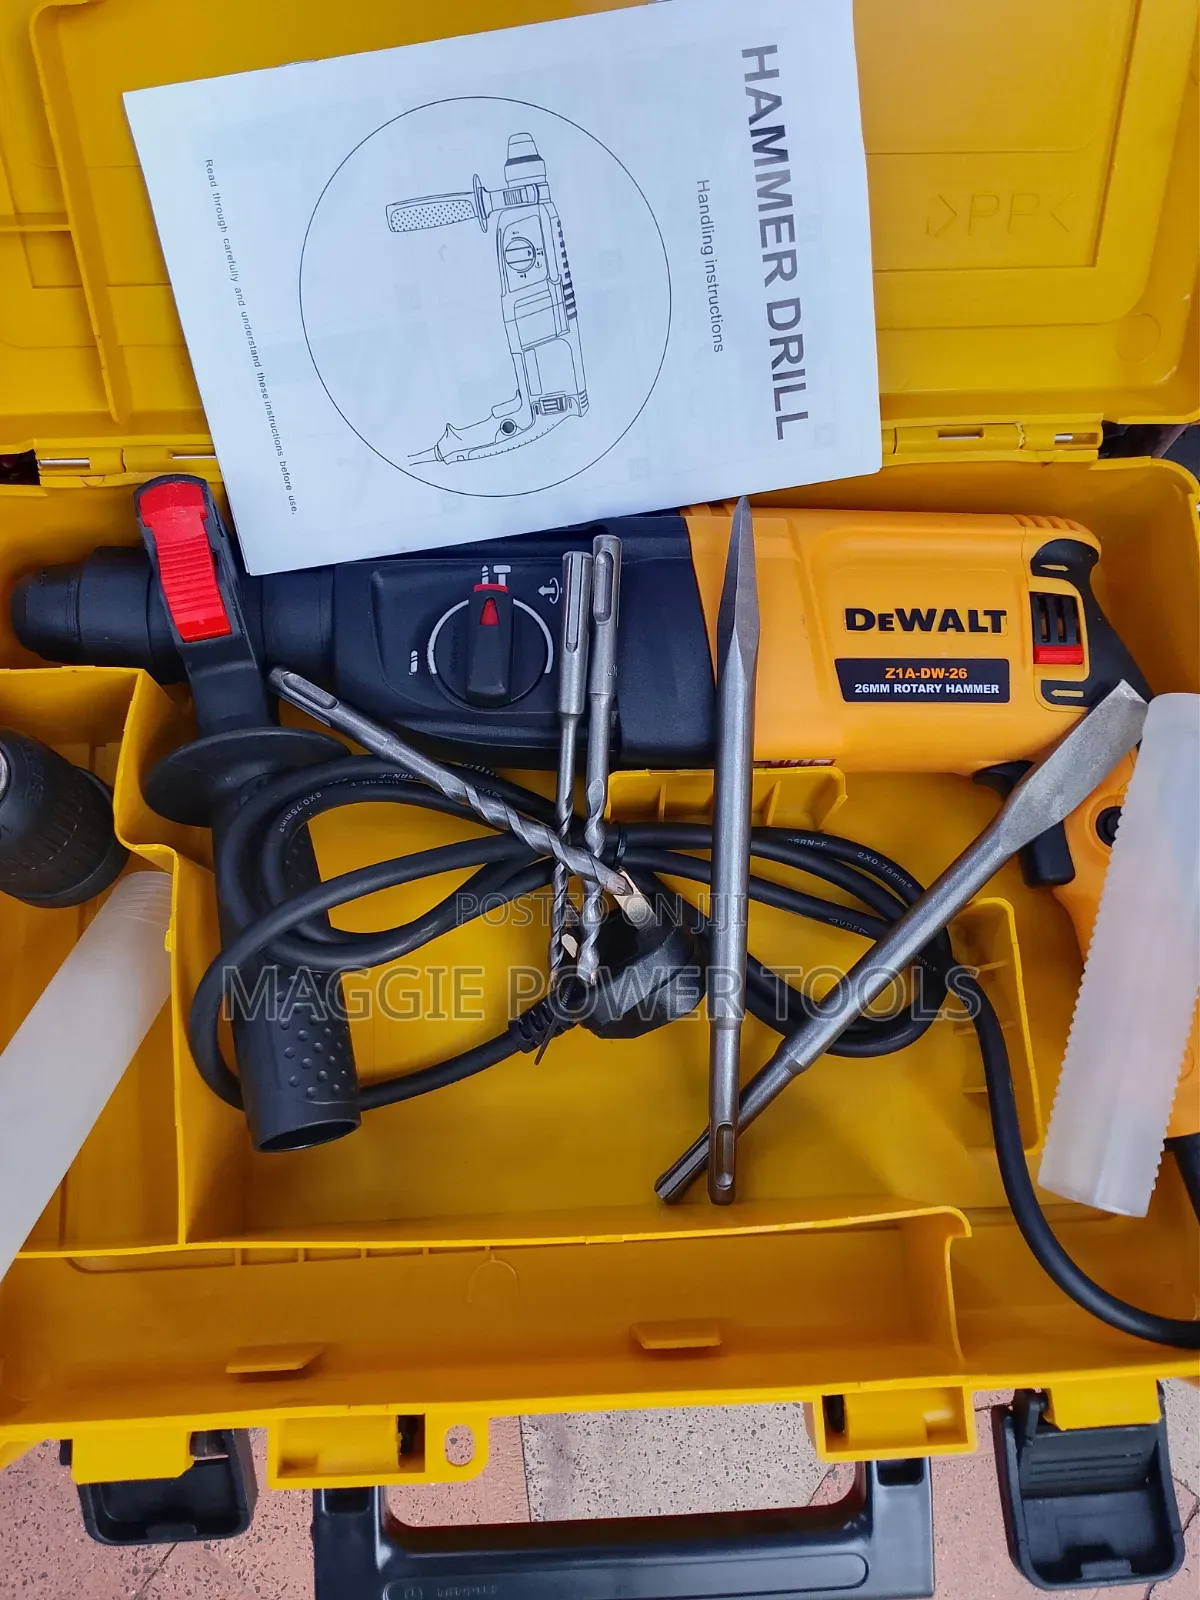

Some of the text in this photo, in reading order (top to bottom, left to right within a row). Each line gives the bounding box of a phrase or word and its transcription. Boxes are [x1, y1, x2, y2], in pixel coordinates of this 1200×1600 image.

[696, 179, 724, 354] Handling instructions
[741, 44, 809, 441] HAMMER DRILL
[204, 159, 298, 515] Read through carefully and understand these instructions before use.
[854, 683, 1000, 695] 26MM ROTARY HAMMER
[885, 667, 968, 680] Z1A-DW-26
